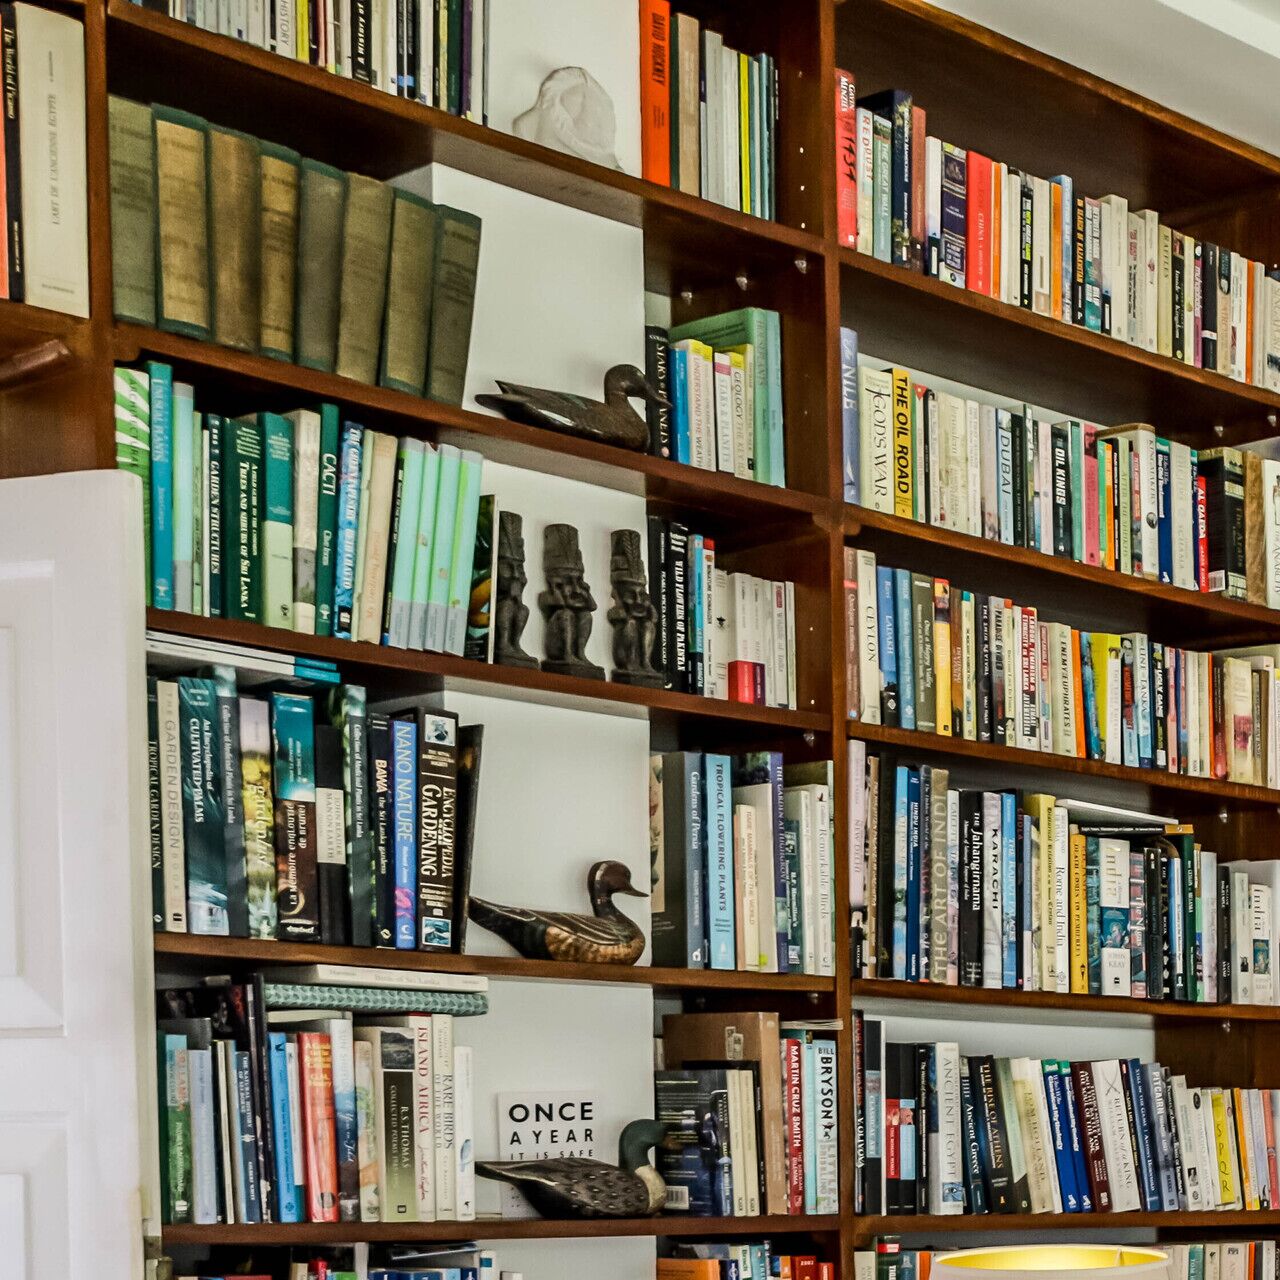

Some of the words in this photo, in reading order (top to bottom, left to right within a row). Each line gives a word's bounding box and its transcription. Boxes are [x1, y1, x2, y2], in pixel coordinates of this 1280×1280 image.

[844, 364, 857, 410] NILE
[896, 376, 908, 404] THE
[896, 411, 908, 438] OIL
[322, 454, 336, 496] CACTI
[896, 444, 908, 493] ROAD
[1001, 435, 1011, 495] DUBAI
[1056, 448, 1065, 467] OIL
[210, 461, 219, 508] GARDEN
[1056, 469, 1066, 505] KINGS
[210, 512, 220, 574] STRUCTURES
[396, 726, 411, 766] NANO
[376, 760, 387, 792] BAWA
[691, 772, 699, 810] Gardens
[715, 763, 724, 806] TROPICAL
[150, 789, 160, 824] GARDEN
[398, 774, 412, 841] NATURE
[151, 828, 161, 868] DESIGN
[422, 784, 441, 877] GARDENING
[442, 786, 456, 878] ENCYCLOPEDIA
[716, 807, 725, 870] FLOWERING
[972, 831, 982, 910] Jahangirnama
[990, 828, 1000, 910] KARACHI
[717, 874, 726, 912] PLANTS
[418, 1026, 428, 1078] ISLAND
[790, 1045, 799, 1083] MARTIN
[818, 1047, 834, 1056] BILL
[792, 1086, 800, 1114] CRUZ
[820, 1057, 832, 1119] BRYSON
[419, 1086, 430, 1134] AFRICA
[508, 1102, 594, 1122] ONCE
[510, 1131, 522, 1144] A
[532, 1129, 594, 1144] YEAR
[792, 1116, 800, 1148] SMITH
[510, 1152, 524, 1160] IT
[536, 1151, 549, 1160] IS
[560, 1148, 594, 1158] SAFE
